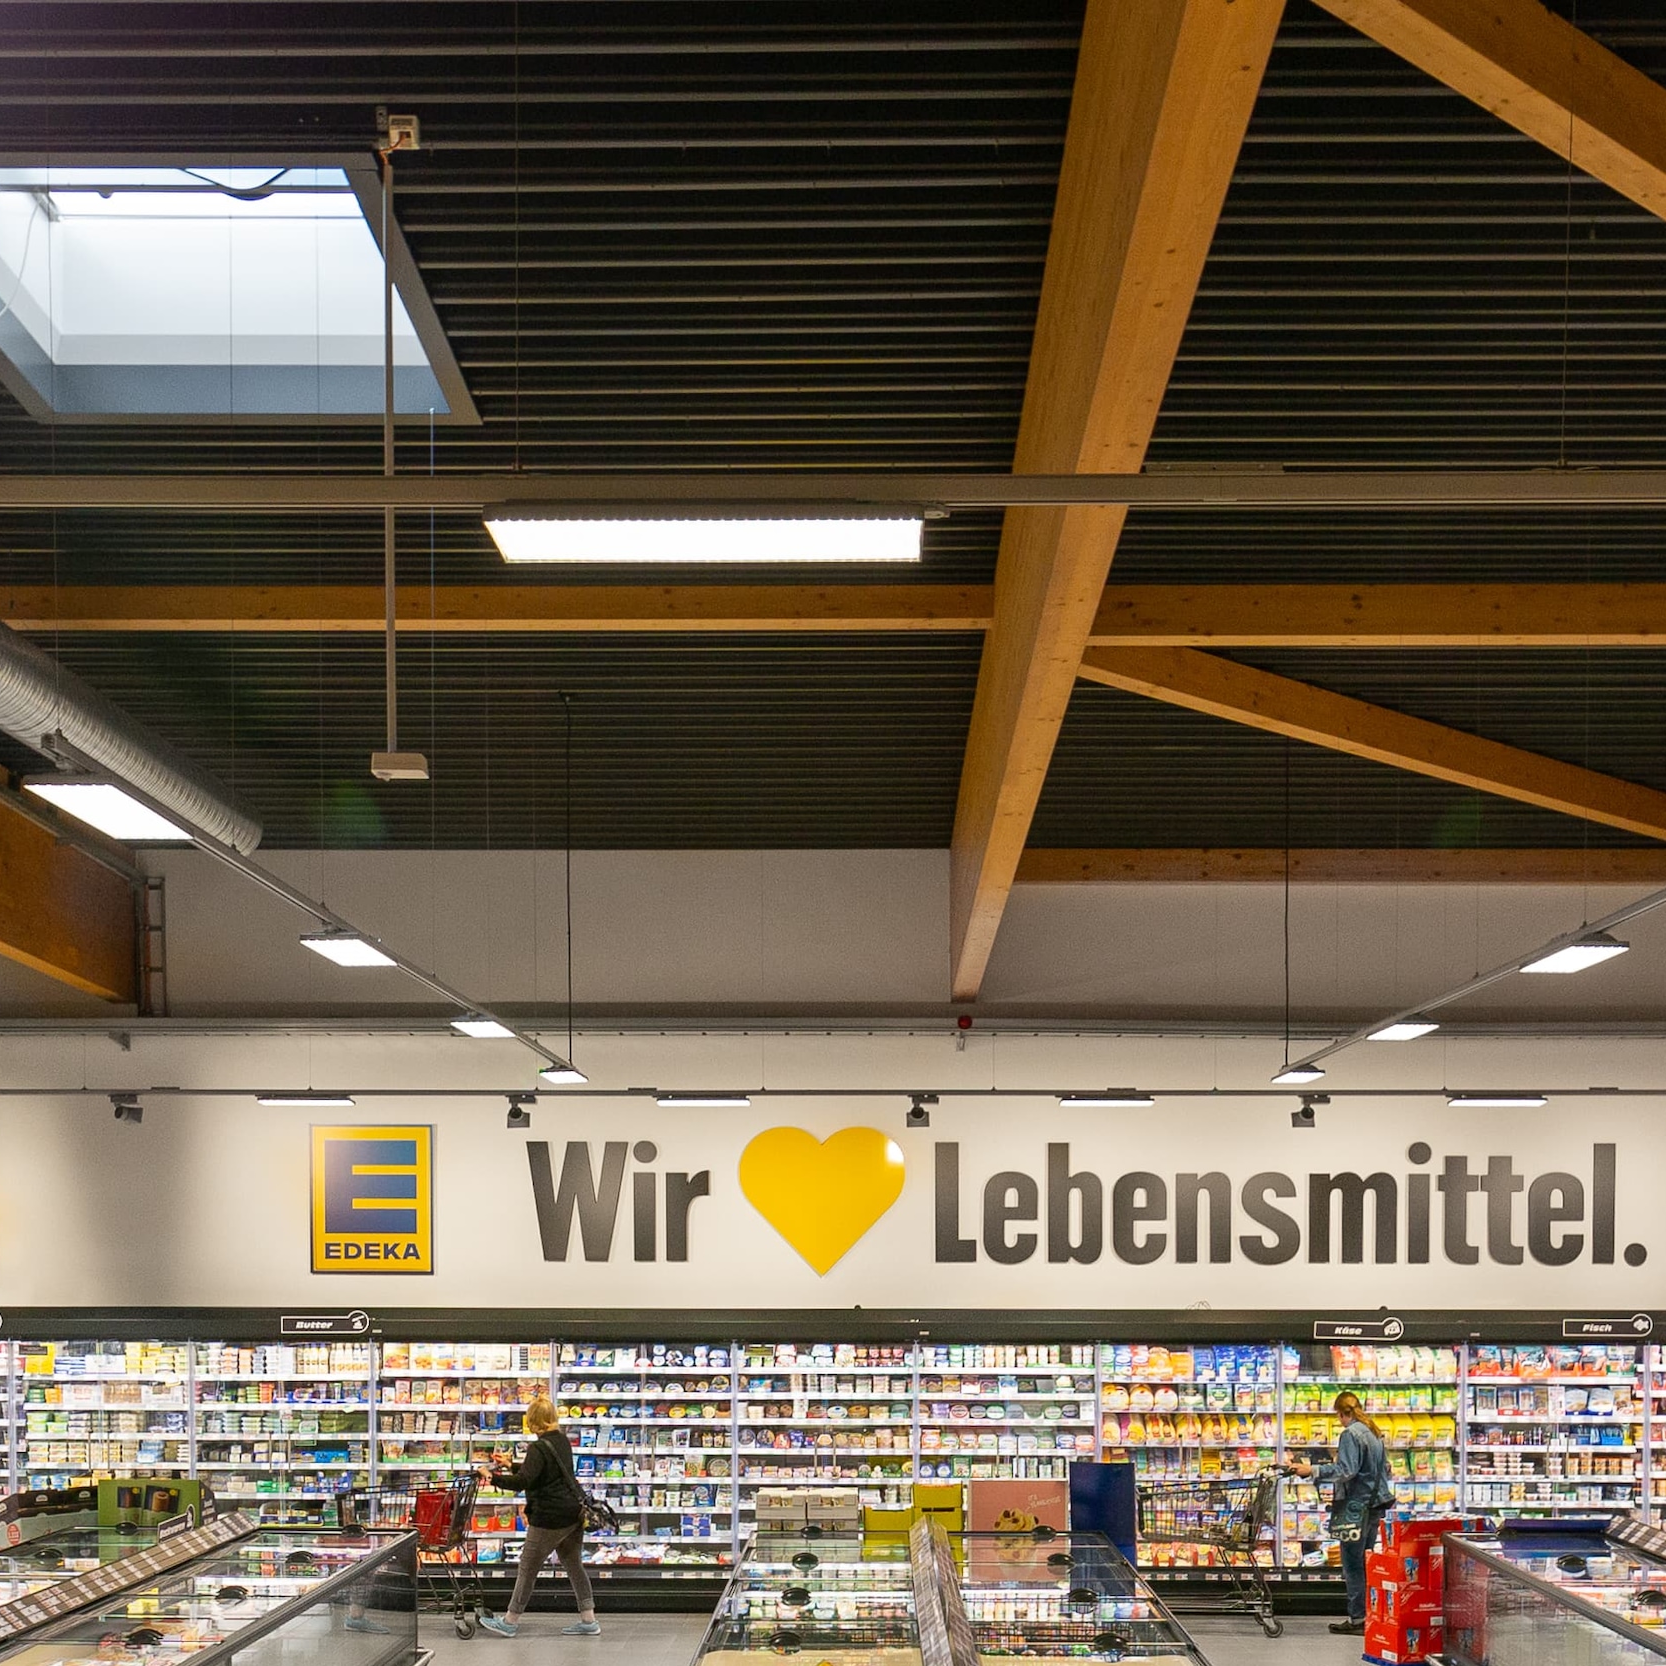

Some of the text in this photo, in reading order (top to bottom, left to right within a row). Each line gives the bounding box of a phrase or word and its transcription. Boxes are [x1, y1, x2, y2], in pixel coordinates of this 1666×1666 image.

[526, 1139, 1648, 1267] Wir Lebensmittel.
[324, 1242, 421, 1261] EDEKA
[295, 1321, 333, 1330] Butter
[1334, 1325, 1363, 1336] Käse
[1582, 1323, 1612, 1333] Fisch
